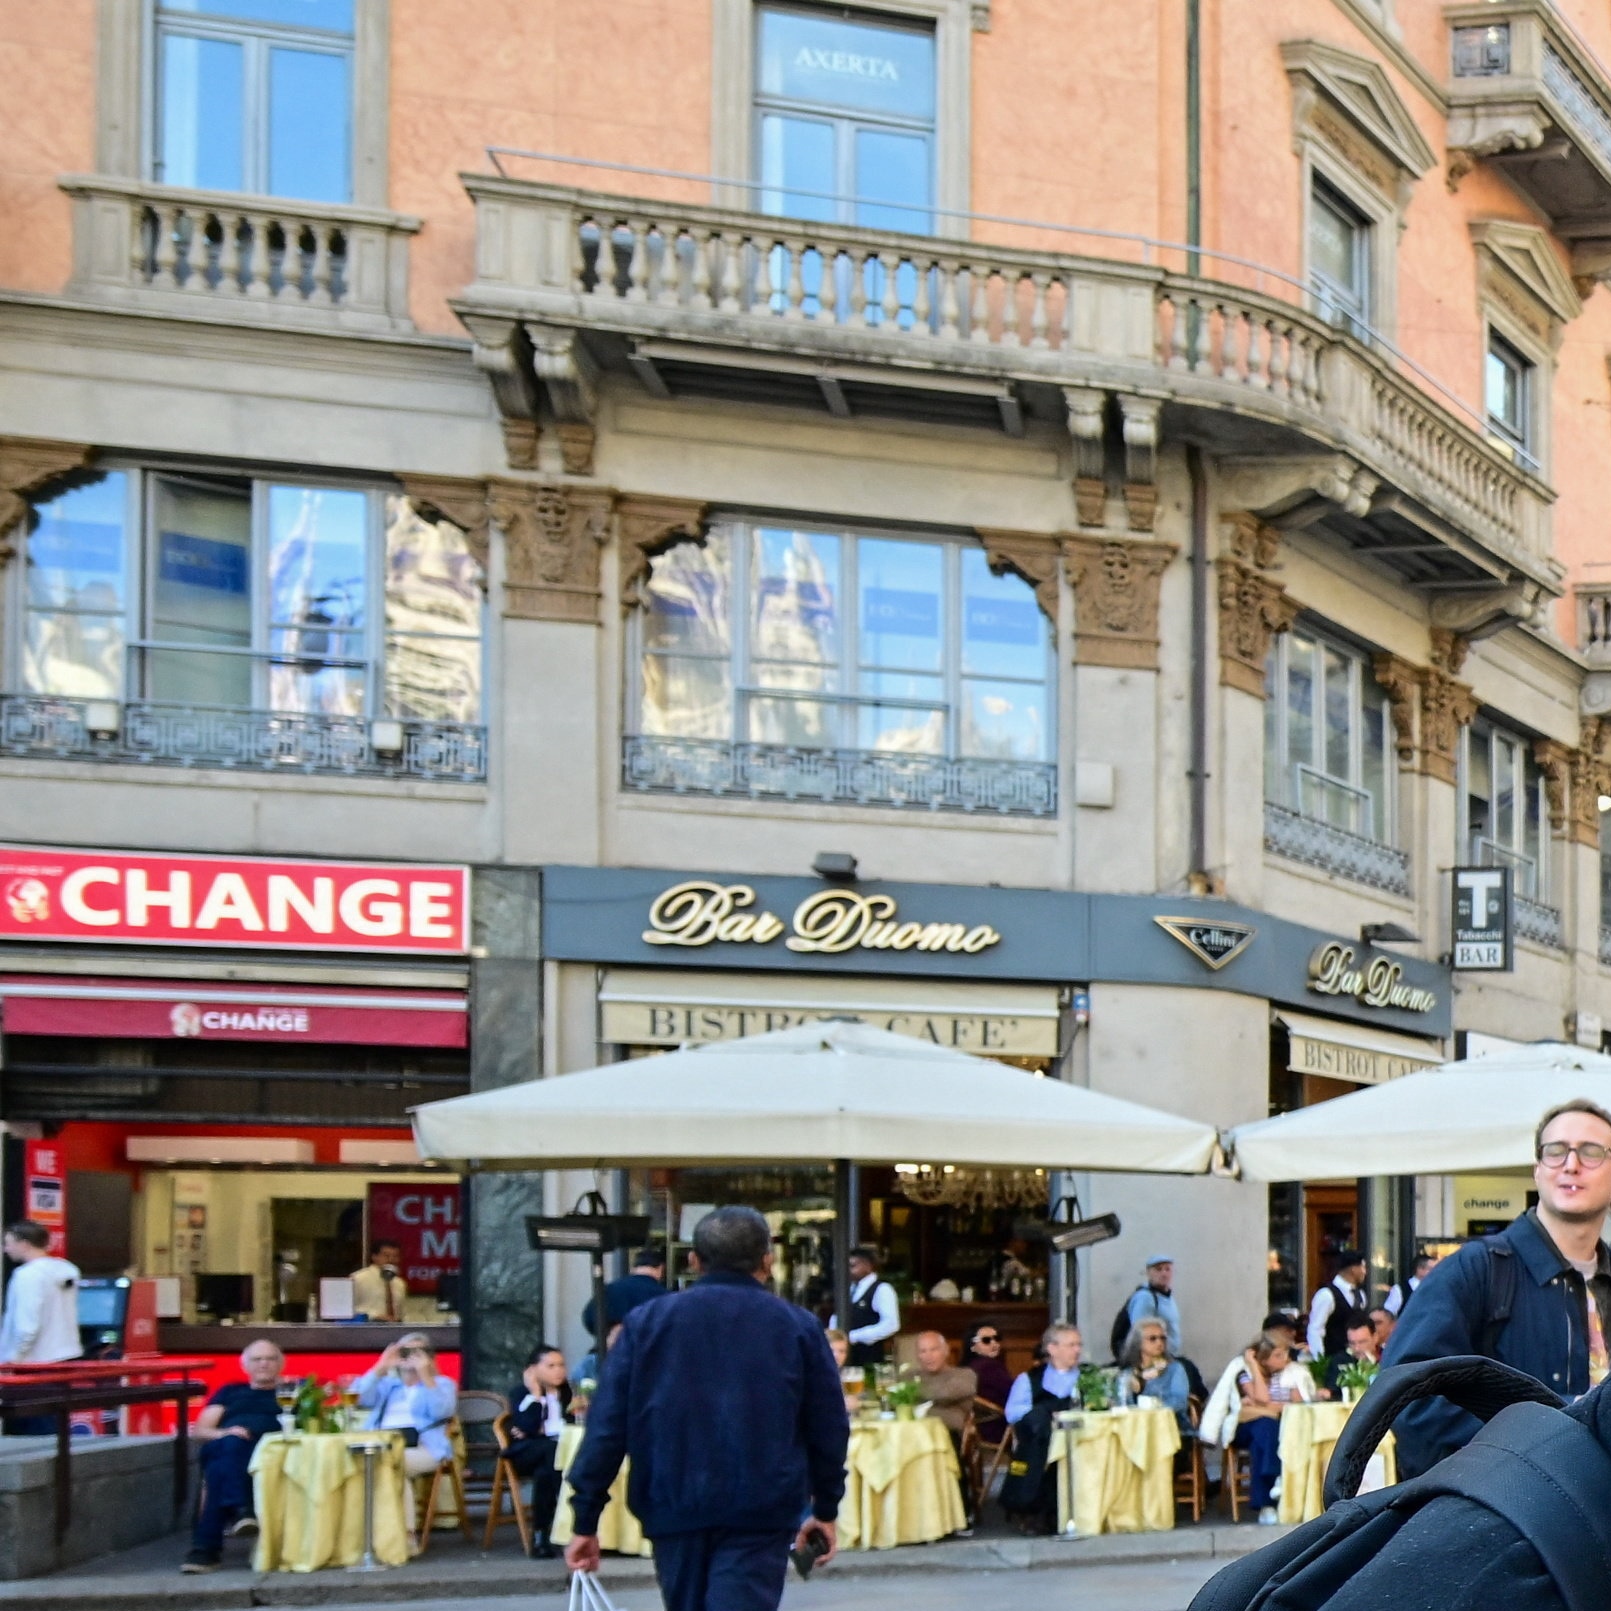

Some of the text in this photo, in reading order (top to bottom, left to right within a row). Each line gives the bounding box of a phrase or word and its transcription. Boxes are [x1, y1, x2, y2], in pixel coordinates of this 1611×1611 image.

[796, 47, 899, 81] AXERTA
[60, 866, 454, 938] CHANGE
[1457, 871, 1502, 929] T
[642, 880, 1001, 953] Bar Duomo
[1189, 928, 1237, 948] Cellini
[1457, 929, 1502, 942] Tabacchi
[1459, 947, 1498, 964] BAR
[1310, 941, 1436, 1013] Bar Duomo
[202, 1011, 309, 1033] CHANGE
[1304, 1041, 1380, 1079] BISTROT
[394, 1194, 461, 1225] CH
[1464, 1197, 1510, 1210] change
